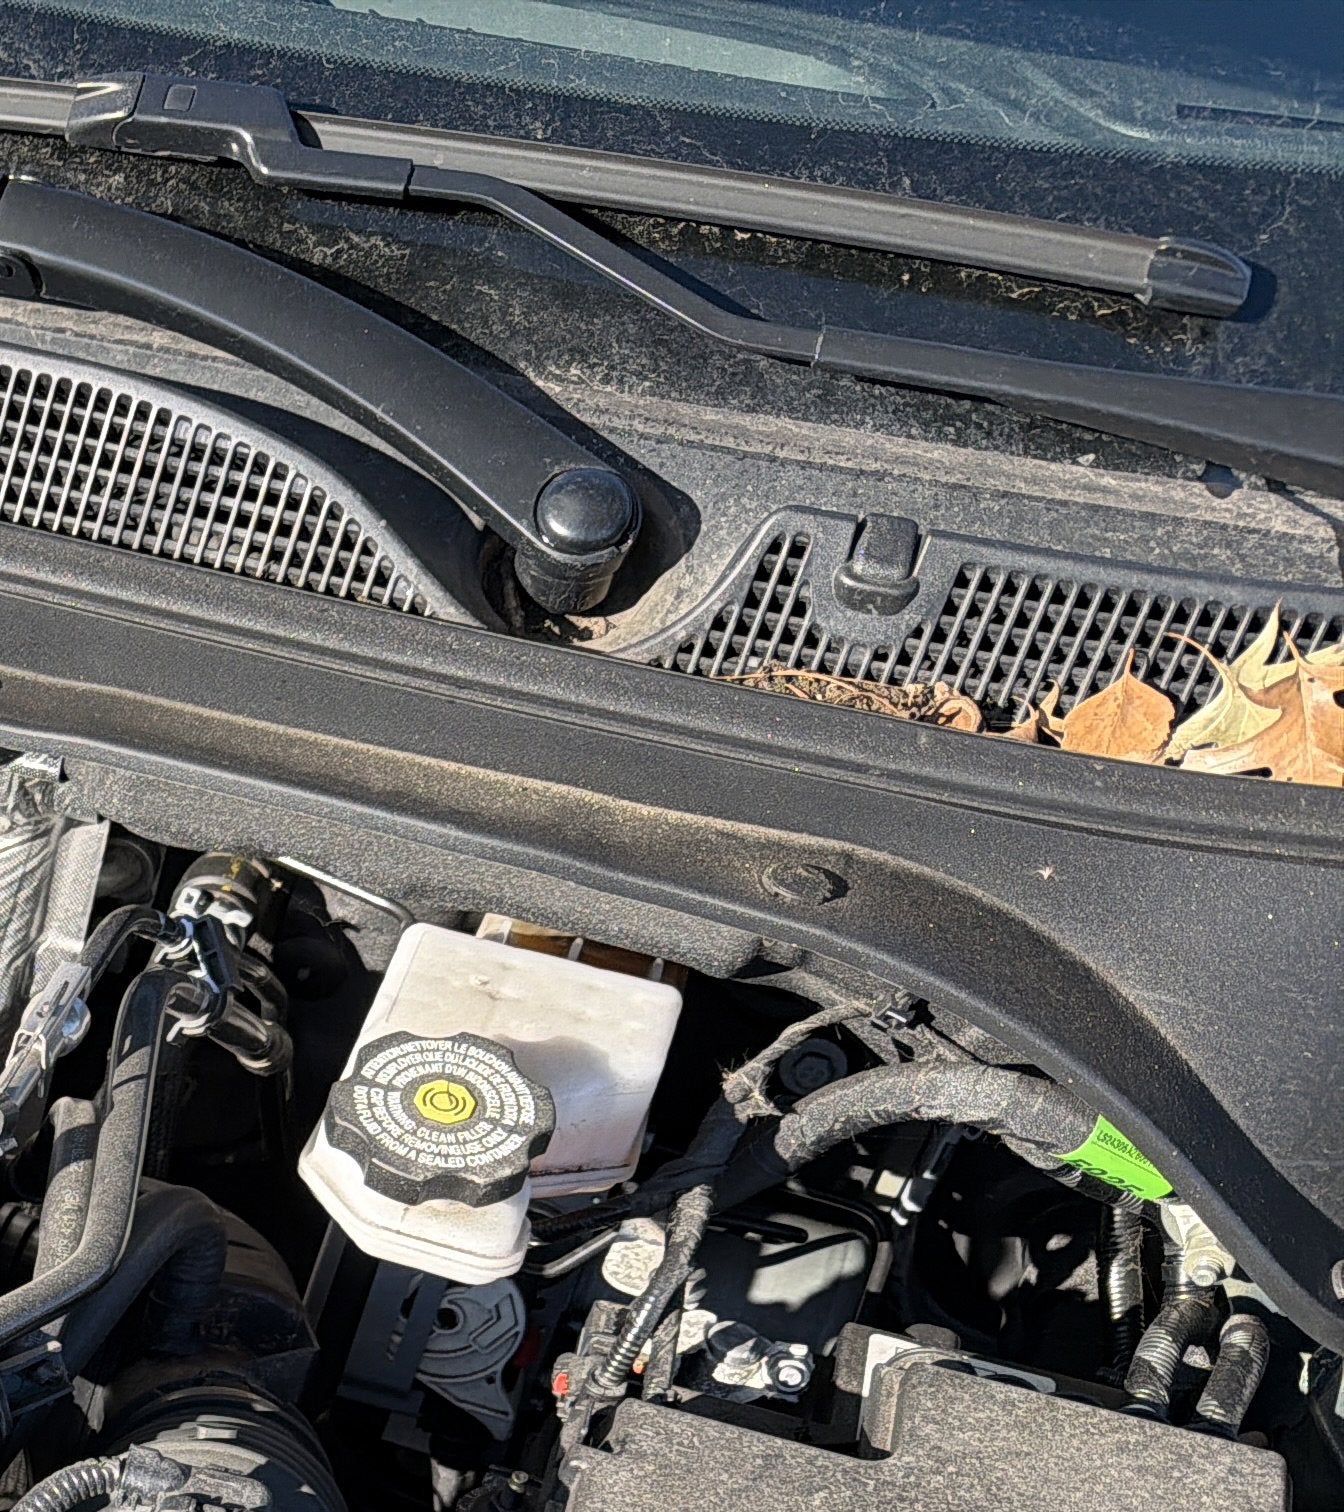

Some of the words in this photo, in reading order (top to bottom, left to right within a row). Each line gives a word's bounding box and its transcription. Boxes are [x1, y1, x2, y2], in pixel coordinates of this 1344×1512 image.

[421, 1050, 442, 1062] QUE
[453, 1042, 468, 1053] LE
[369, 1086, 386, 1106] CAP
[372, 1106, 406, 1138] BEFORE
[416, 1127, 456, 1143] CLEAN
[458, 1121, 492, 1143] FILLER
[356, 1109, 384, 1136] FLUID
[376, 1132, 410, 1156] FROM
[408, 1149, 418, 1160] A
[418, 1153, 466, 1167] SEALED
[479, 1126, 510, 1148] ONLY
